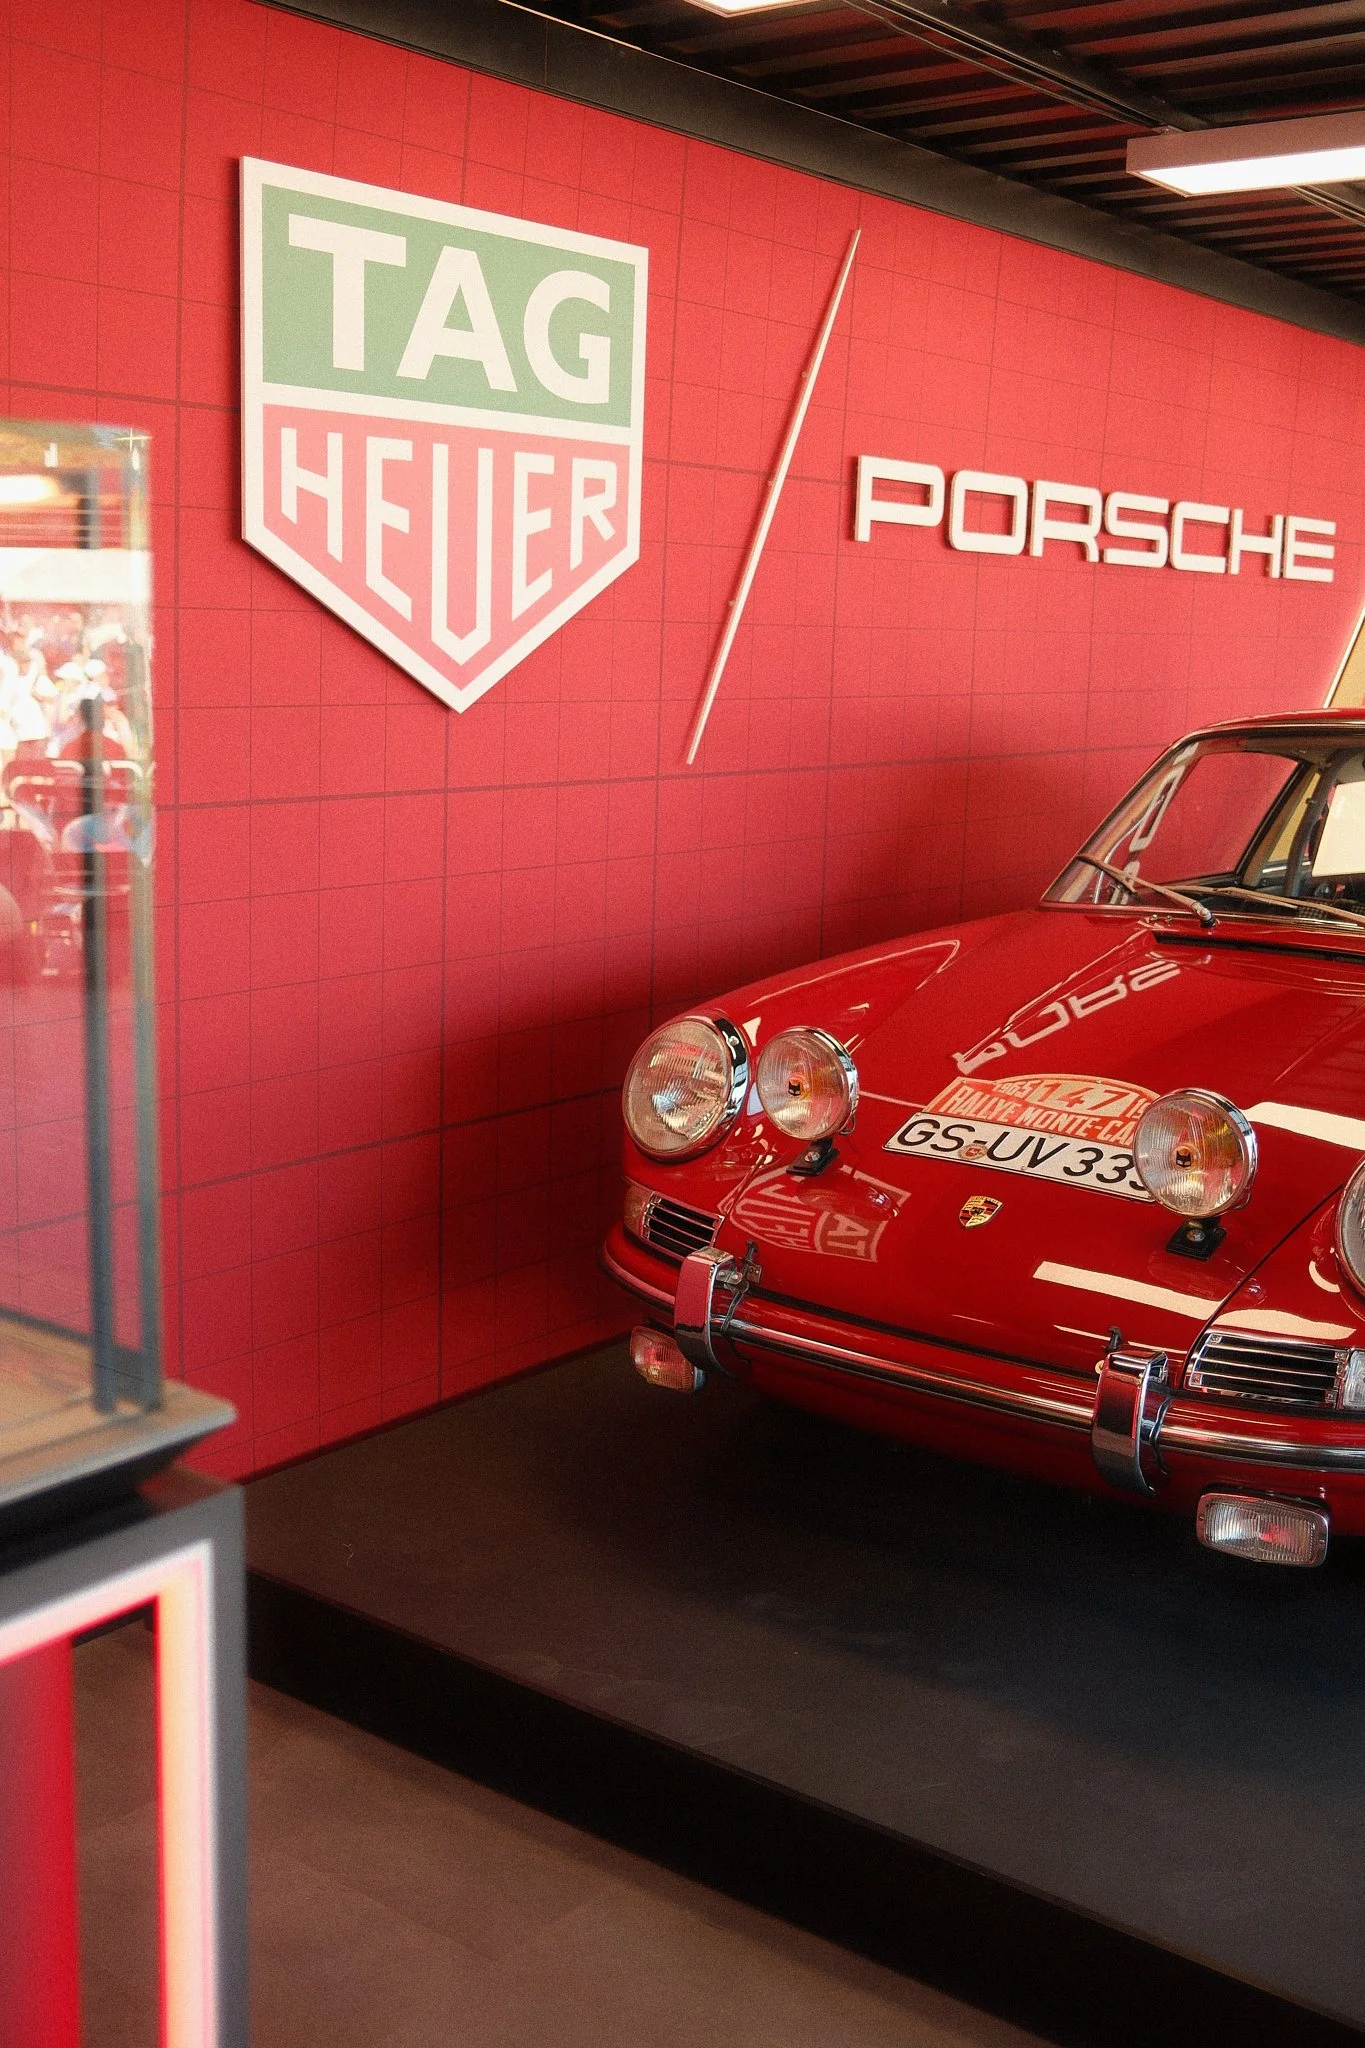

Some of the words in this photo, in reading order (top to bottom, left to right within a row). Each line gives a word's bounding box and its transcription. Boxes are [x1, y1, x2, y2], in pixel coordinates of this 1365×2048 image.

[288, 213, 611, 405] TAG
[280, 427, 618, 666] HEUER
[854, 455, 1337, 583] PORSCHE
[939, 1085, 1022, 1122] RALLYE
[1014, 1107, 1137, 1146] MONTE-CA
[992, 1080, 1041, 1098] 1965
[1040, 1082, 1130, 1111] 147
[897, 1118, 1070, 1169] GS-UV
